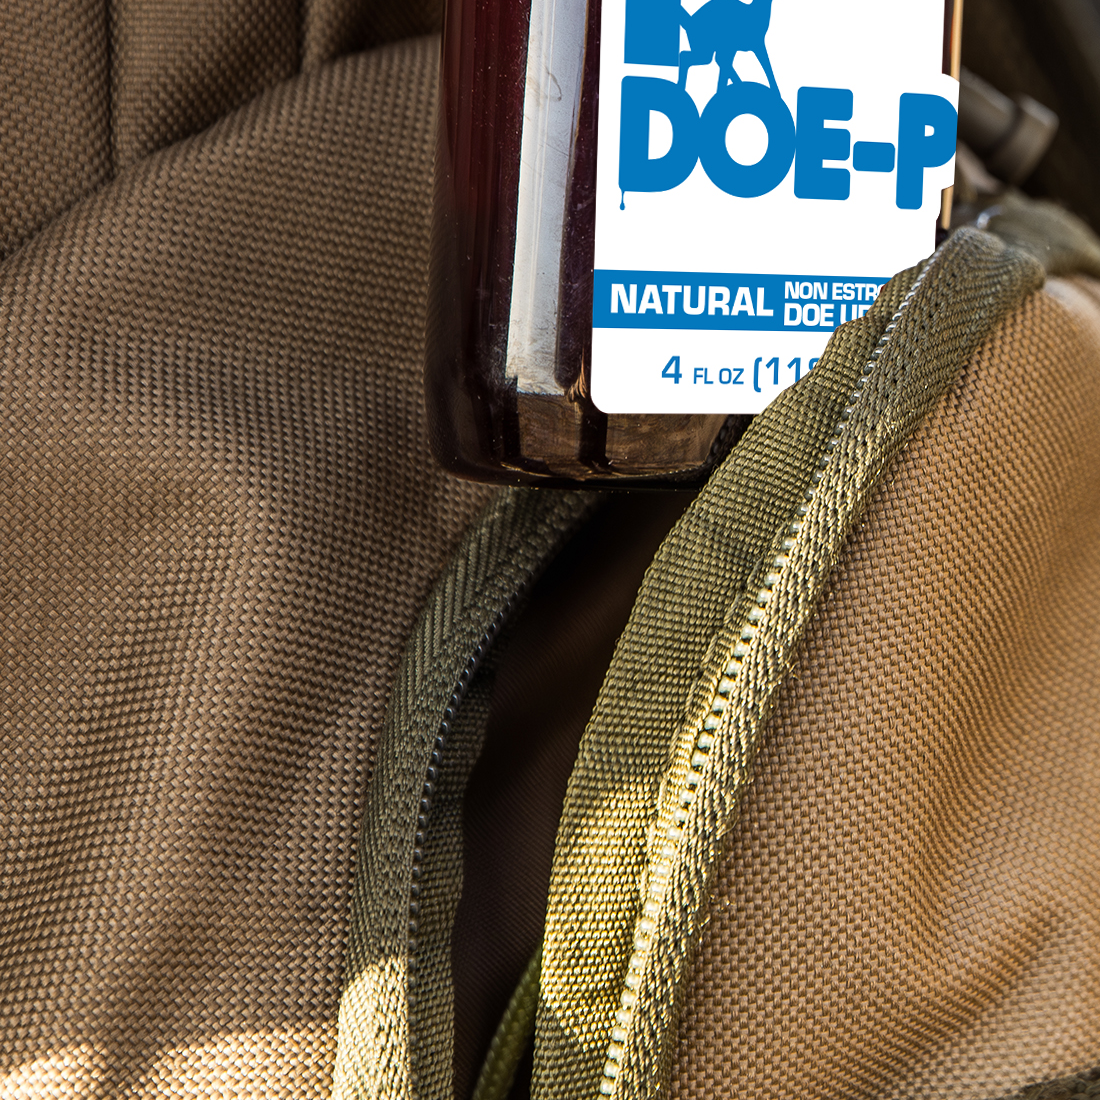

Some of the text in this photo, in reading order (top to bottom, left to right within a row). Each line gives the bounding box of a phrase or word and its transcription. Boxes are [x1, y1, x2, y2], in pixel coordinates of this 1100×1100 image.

[618, 76, 958, 210] DOE-P
[610, 283, 774, 317] NATURAL
[784, 281, 828, 300] NON
[783, 303, 834, 327] DOE
[661, 356, 820, 393] 4 FL OZ (11
